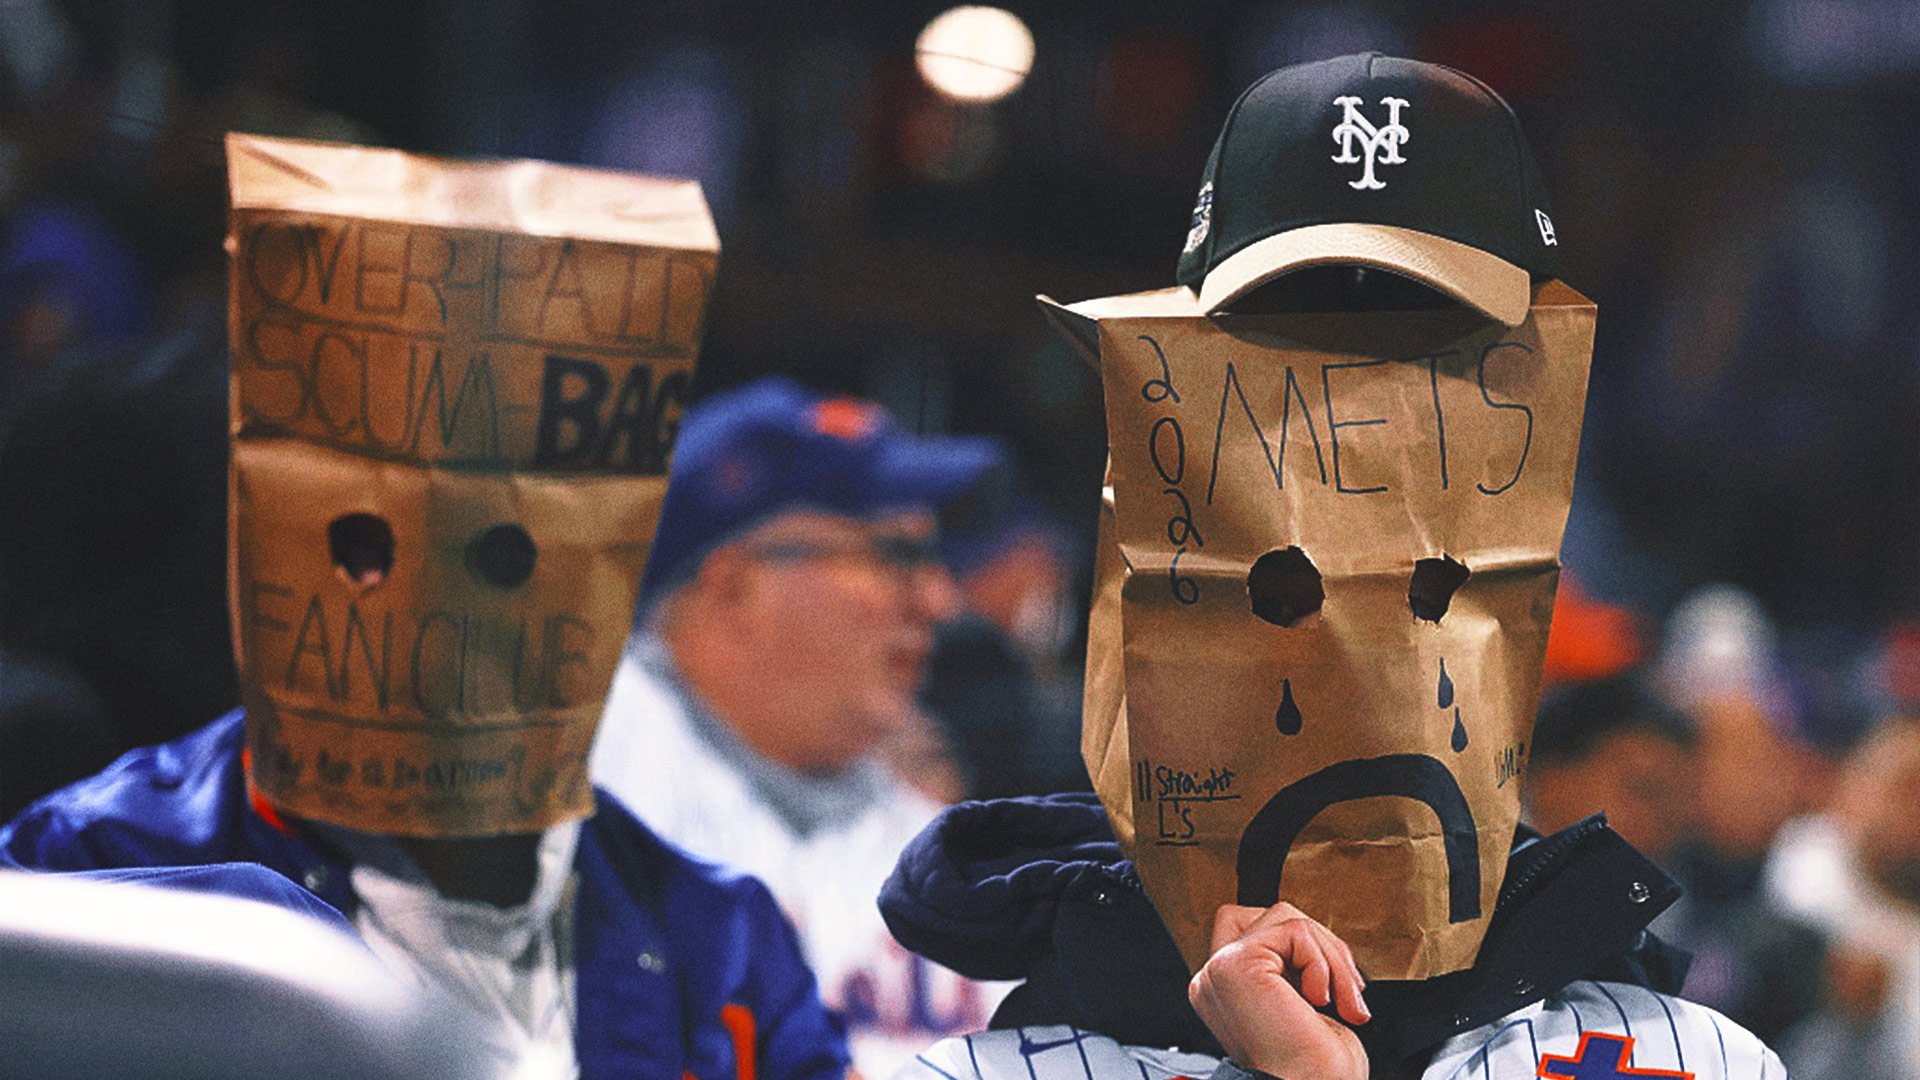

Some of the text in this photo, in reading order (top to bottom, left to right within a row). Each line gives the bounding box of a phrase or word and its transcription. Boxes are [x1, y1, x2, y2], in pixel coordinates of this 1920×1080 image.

[1138, 334, 1205, 606] 2026
[1207, 342, 1534, 506] METS
[1155, 765, 1237, 800] Straight
